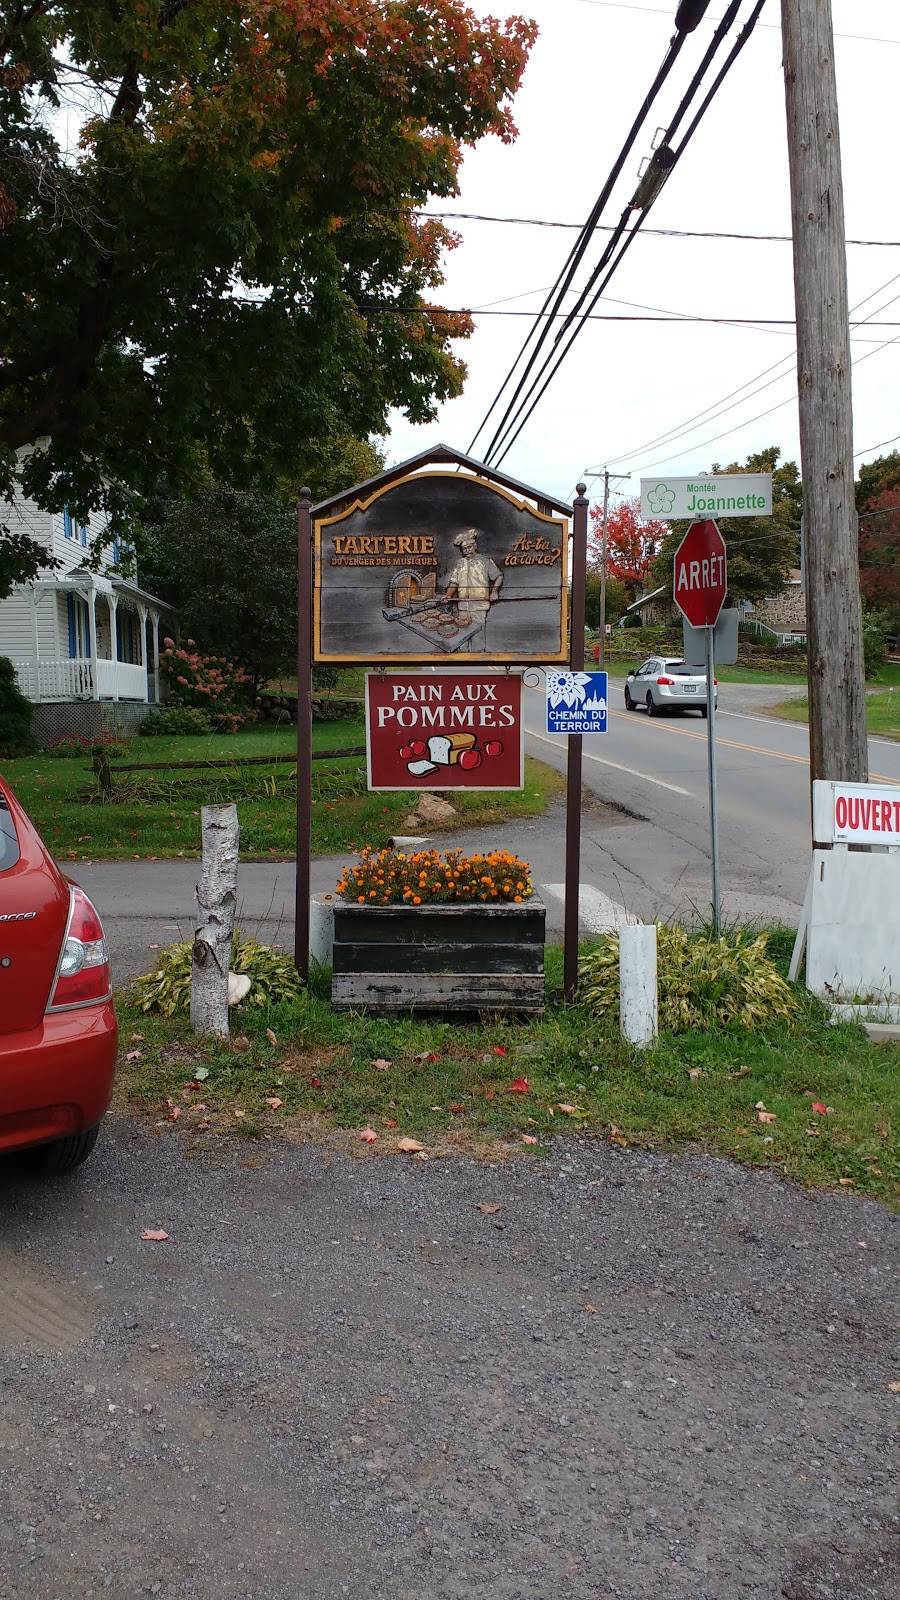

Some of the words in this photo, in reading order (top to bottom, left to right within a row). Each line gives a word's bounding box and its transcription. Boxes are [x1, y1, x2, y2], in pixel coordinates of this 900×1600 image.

[686, 484, 716, 493] Montée
[687, 494, 766, 511] Joannette
[332, 536, 434, 554] TARTERIE
[331, 558, 342, 566] DU
[344, 558, 375, 566] VERGER
[376, 558, 391, 566] DES
[393, 558, 438, 566] MUSIQUES
[677, 552, 724, 591] ARRÊT
[392, 685, 443, 702] PAIN
[450, 684, 498, 701] AUX
[376, 705, 515, 728] POMMES
[549, 711, 587, 720] CHEMIN
[591, 711, 606, 720] DU
[554, 721, 600, 731] TERROIR
[836, 796, 900, 833] OUVERT
